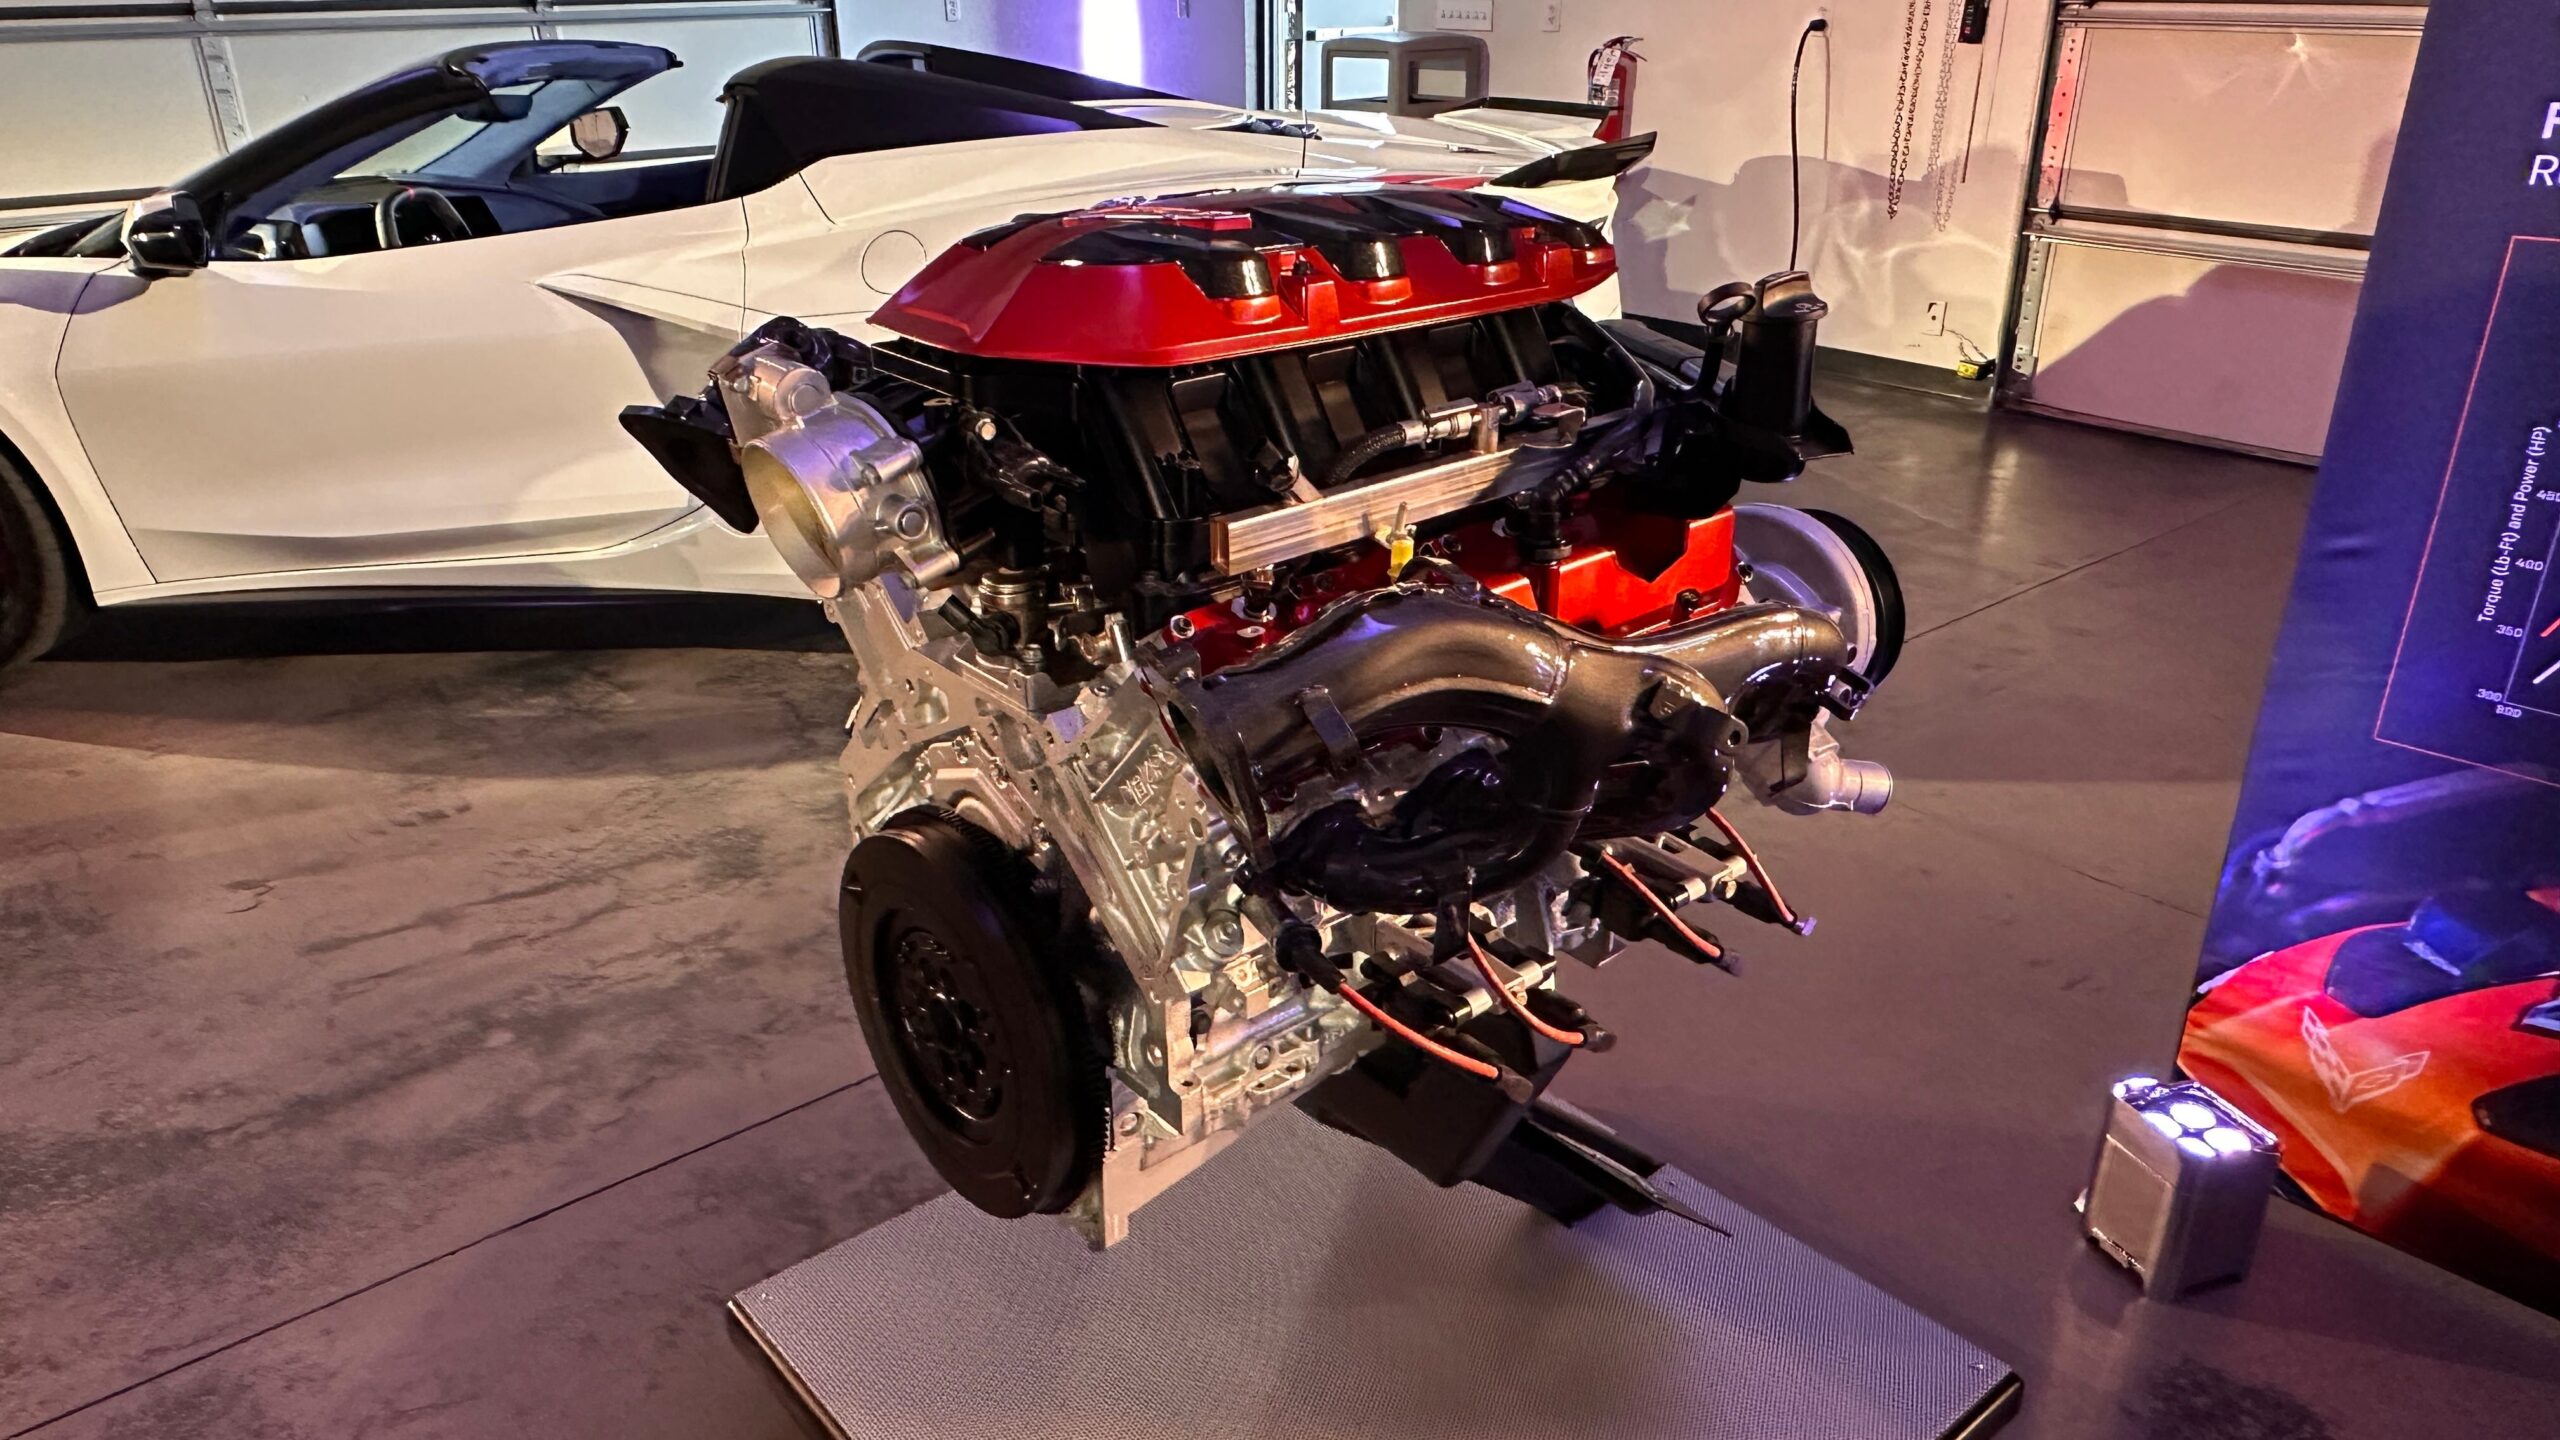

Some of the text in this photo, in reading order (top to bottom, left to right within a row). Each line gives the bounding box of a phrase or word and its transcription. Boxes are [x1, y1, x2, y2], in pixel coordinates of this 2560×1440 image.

[2525, 426, 2552, 456] (HP)
[2513, 458, 2540, 502] Power
[2508, 503, 2526, 529] and
[2515, 558, 2544, 571] 400
[2477, 579, 2504, 621] Torque
[2496, 624, 2523, 638] 350
[2477, 688, 2502, 702] 300
